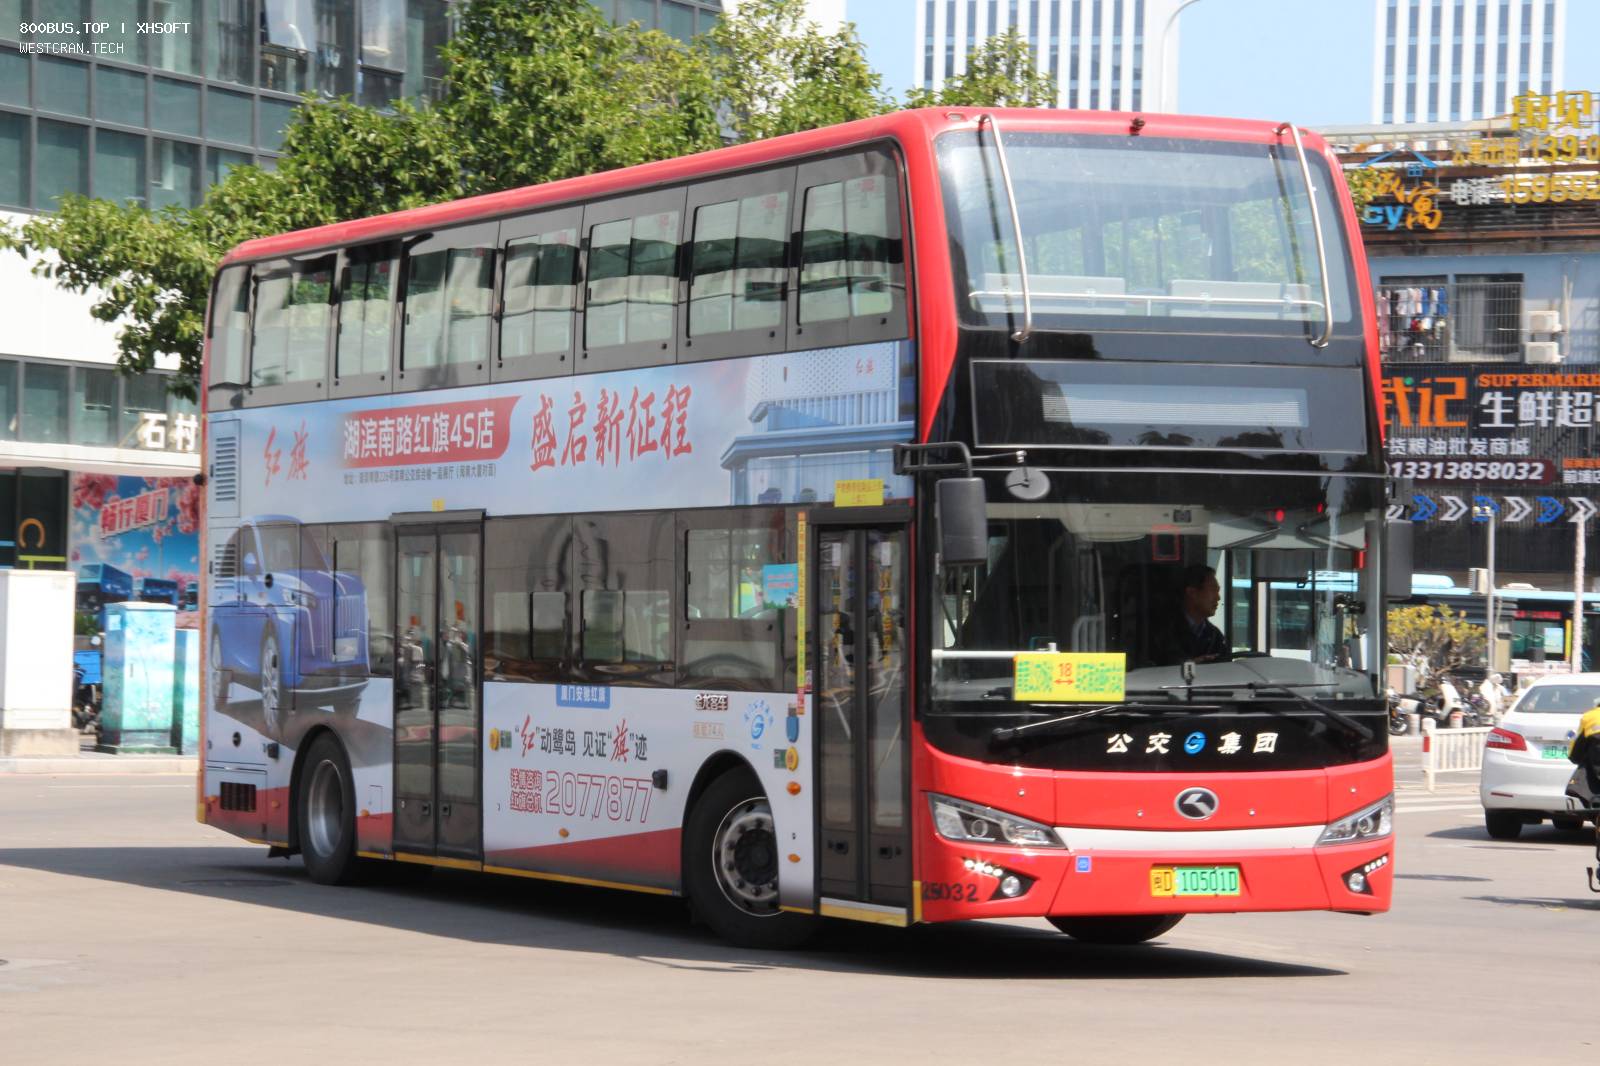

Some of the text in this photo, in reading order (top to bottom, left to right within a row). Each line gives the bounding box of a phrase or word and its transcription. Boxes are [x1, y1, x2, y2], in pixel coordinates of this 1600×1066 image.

[343, 408, 495, 460] 湖滨南路红旗4S店
[529, 383, 693, 472] 盛启新征程
[1479, 391, 1600, 428] 生鲜超
[263, 419, 310, 489] 红旗
[1384, 437, 1531, 456] 货粮油批发商城
[1391, 461, 1545, 480] 13313858032
[546, 770, 653, 823] 2077877
